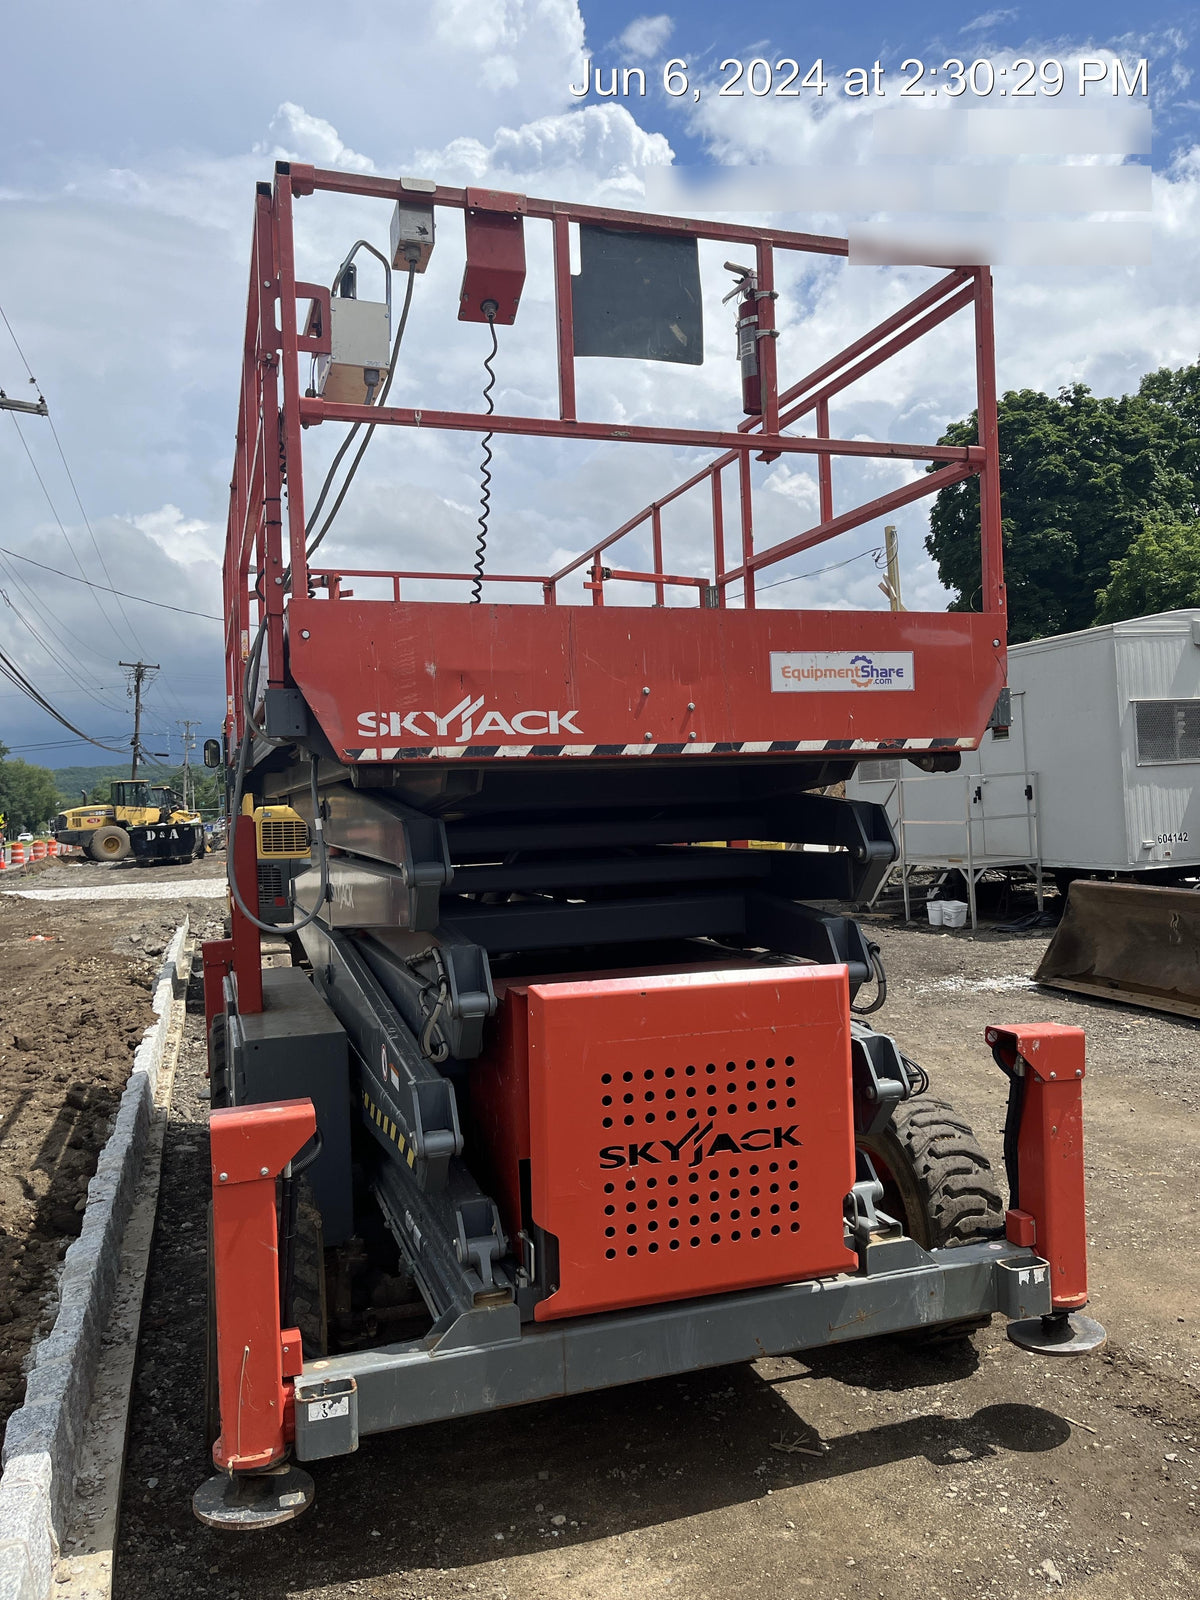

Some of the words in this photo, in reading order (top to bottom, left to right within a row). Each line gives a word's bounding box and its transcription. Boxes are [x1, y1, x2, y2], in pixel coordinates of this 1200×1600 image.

[781, 665, 904, 682] EquipmentShare
[356, 694, 585, 743] SKYJACK
[146, 830, 156, 841] D
[169, 828, 179, 840] A
[1157, 832, 1189, 844] 604142
[598, 1119, 804, 1170] SKYJACK
